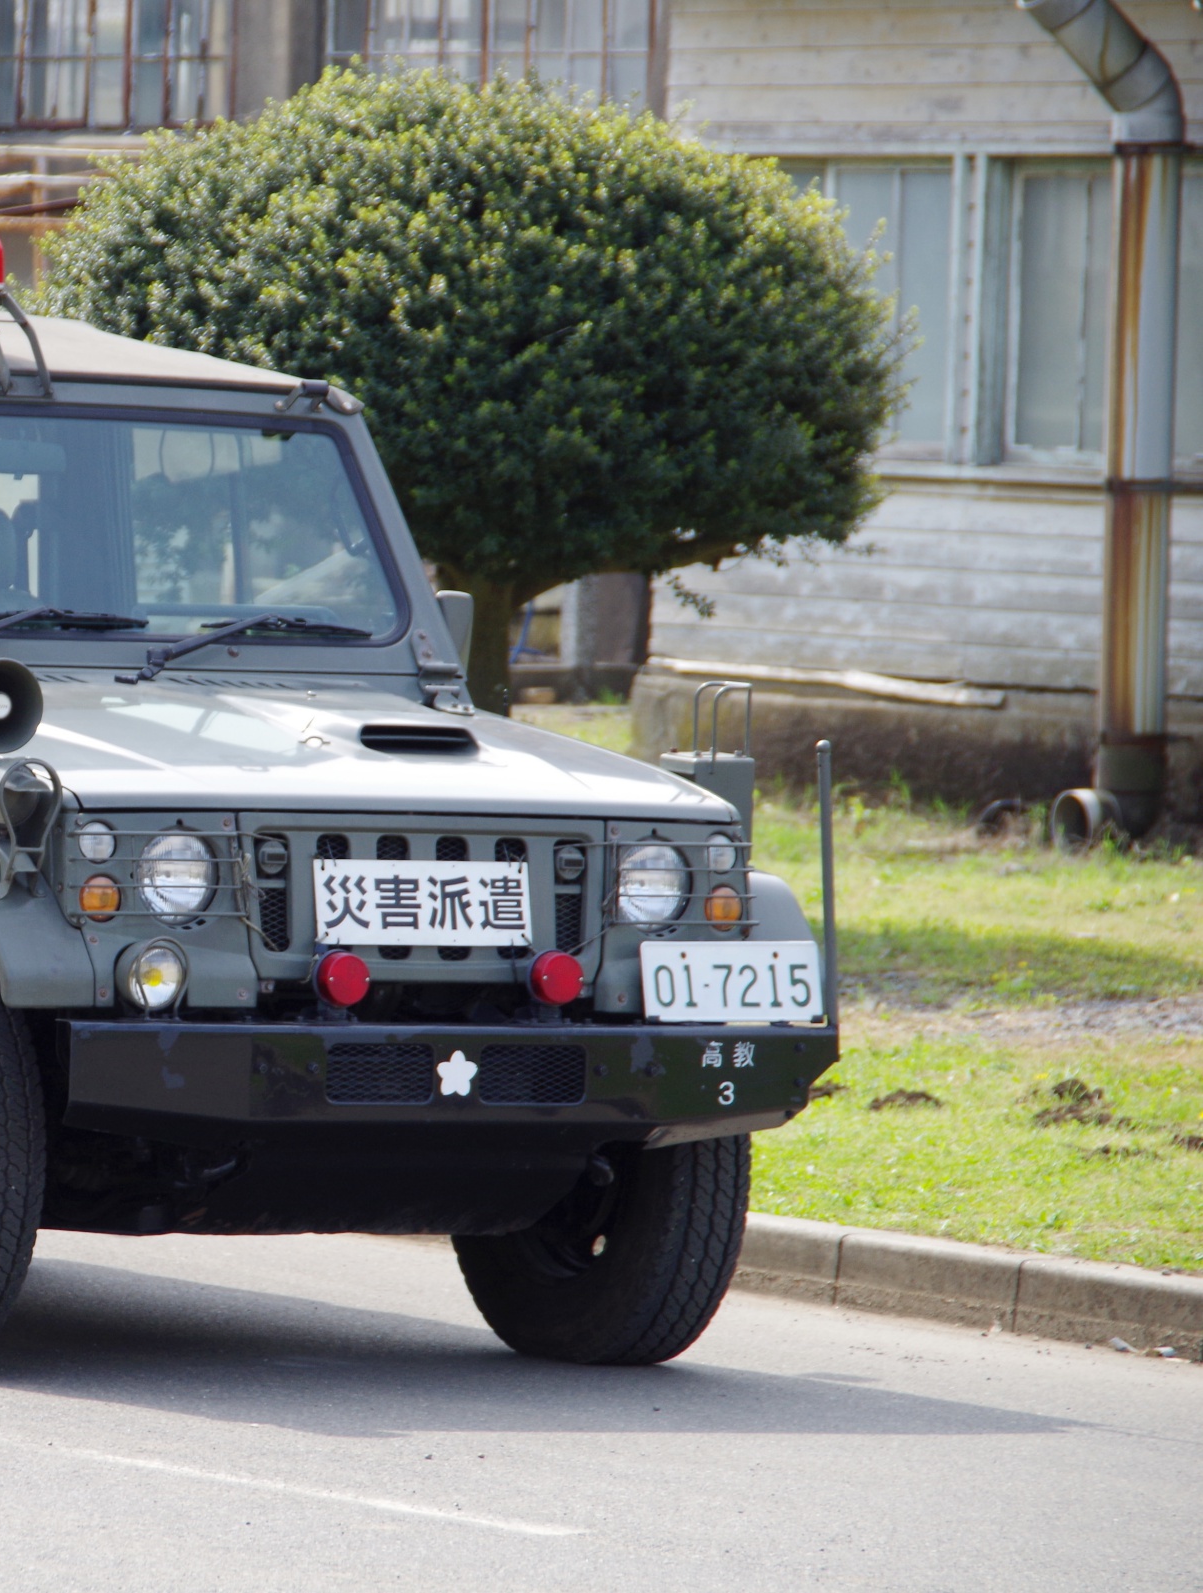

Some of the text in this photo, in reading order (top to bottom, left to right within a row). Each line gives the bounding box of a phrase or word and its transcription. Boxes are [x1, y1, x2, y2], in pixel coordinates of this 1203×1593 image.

[323, 874, 526, 930] 災害派遣
[654, 964, 811, 1008] 01-7215
[718, 1081, 735, 1105] 3
